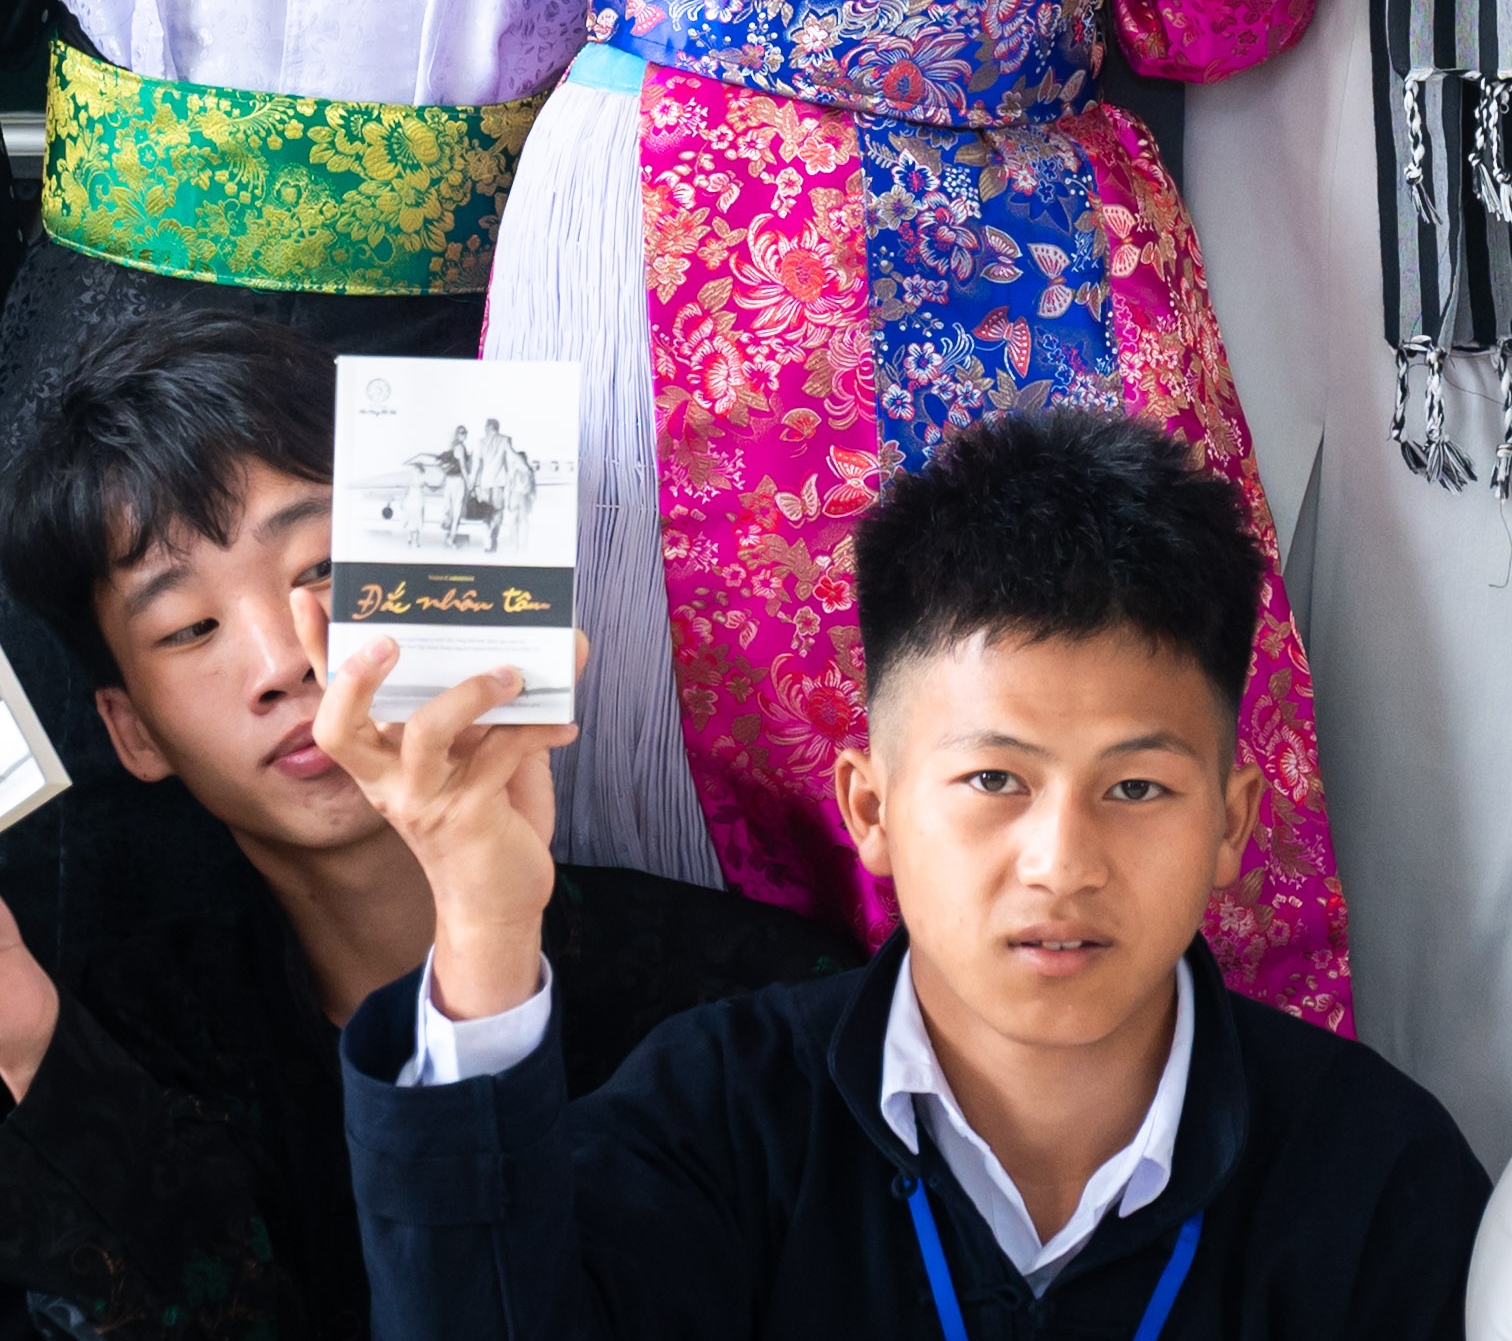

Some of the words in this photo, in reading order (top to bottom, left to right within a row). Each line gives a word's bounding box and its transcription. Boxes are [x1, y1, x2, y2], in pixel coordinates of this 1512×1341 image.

[352, 581, 411, 620] Đắc
[416, 588, 493, 611] nhân
[502, 587, 551, 613] tâm
